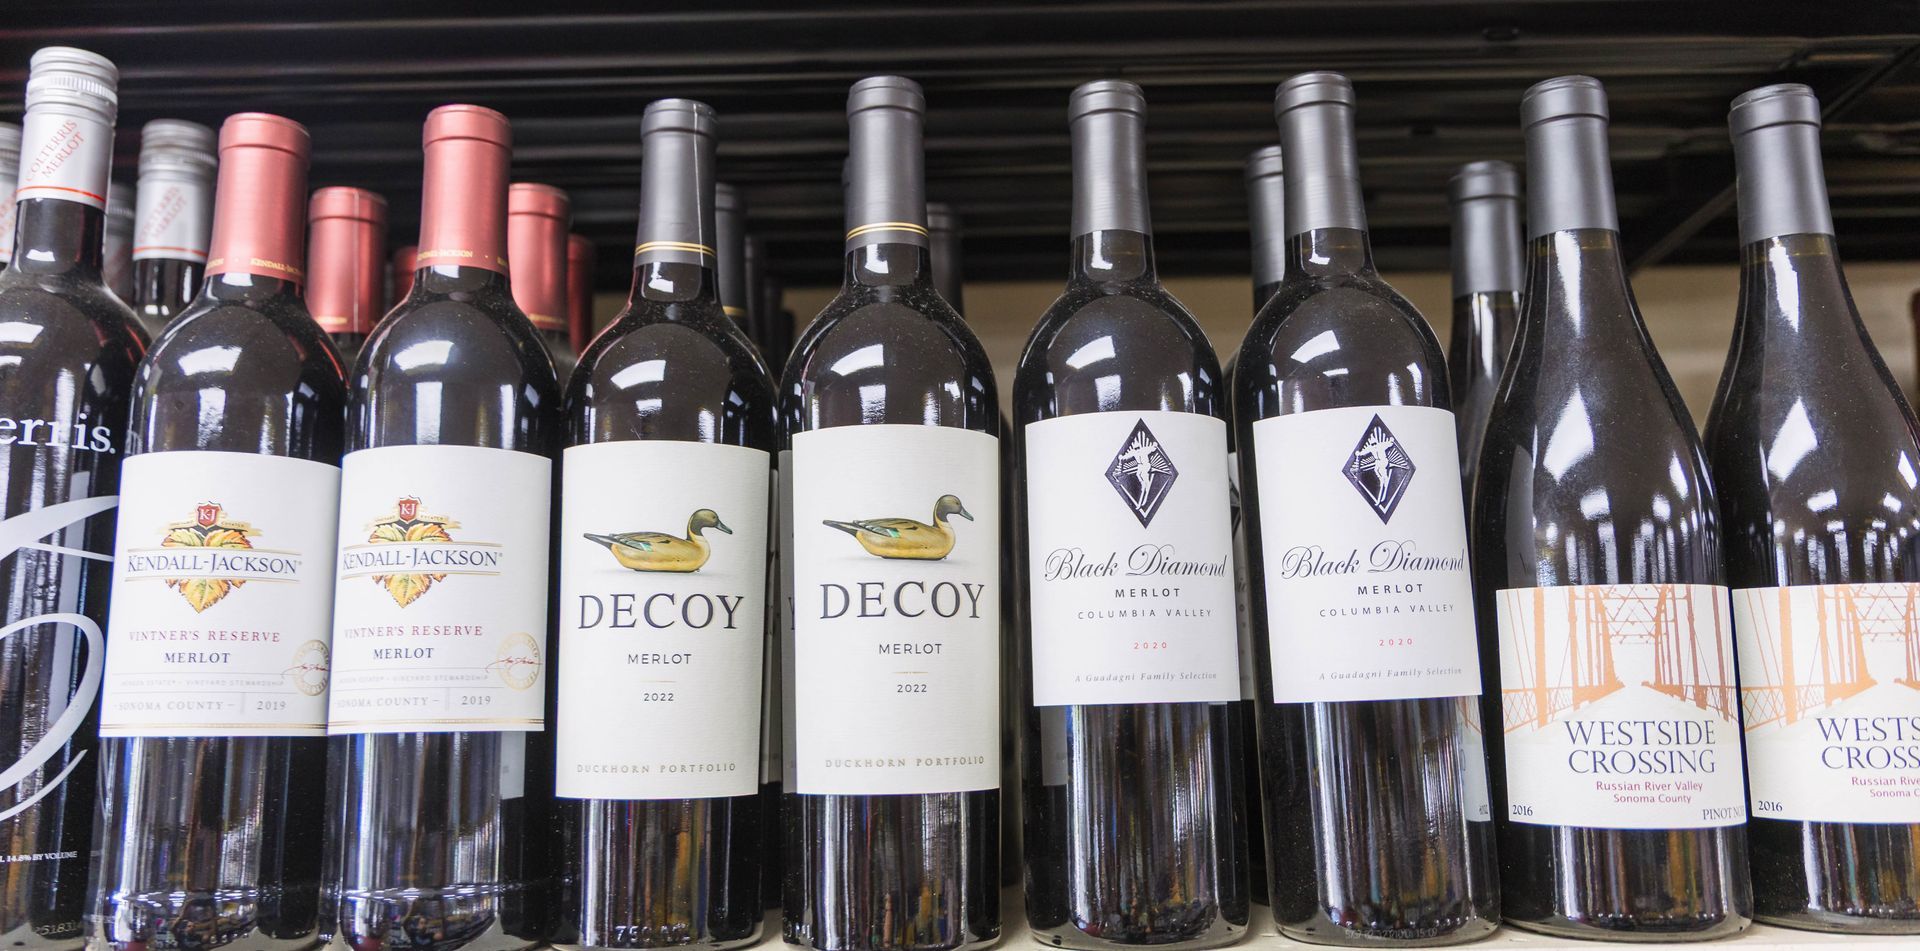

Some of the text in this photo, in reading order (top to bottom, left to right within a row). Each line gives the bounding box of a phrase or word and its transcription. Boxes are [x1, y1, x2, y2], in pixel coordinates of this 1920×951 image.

[41, 131, 84, 178] MERLOT
[1045, 543, 1227, 581] Black Diamond
[1281, 540, 1465, 580] Black Diamond
[1115, 588, 1181, 598] MERLOT
[1357, 583, 1423, 595] MERLOT
[820, 580, 985, 620] DECOY
[578, 592, 745, 630] DECOY
[1078, 609, 1212, 619] COLUMBIA VALLEY
[1319, 604, 1454, 617] COLUMBIA VALLEY
[129, 630, 281, 642] VINTNER'S RESERVE
[344, 625, 483, 639] VINTNER'S RESERVE
[1134, 641, 1168, 650] 2020
[1379, 638, 1413, 646] 2020
[373, 647, 434, 659] MERLOT
[878, 643, 942, 655] MERLOT
[164, 652, 231, 664] MERLOT
[627, 653, 692, 665] MERLOT
[1075, 672, 1217, 683] A Guadagni Family Selection
[1331, 669, 1382, 680] Guadagni
[1387, 668, 1423, 678] Family
[1426, 667, 1462, 675] Selection
[897, 684, 928, 693] 2022
[377, 697, 429, 706] COUNTY
[461, 695, 492, 705] 2019
[643, 692, 675, 702] 2022
[167, 700, 223, 711] COUNTY
[257, 700, 287, 711] 2019
[1564, 719, 1716, 745] WESTSIDE
[825, 755, 985, 768] DUCKHORN PORTFOLIO
[1568, 749, 1716, 774] CROSSING
[577, 763, 736, 774] DUCKHORN PORTFOLIO
[1596, 780, 1703, 792] Russian River Valley
[1851, 776, 1897, 786] Russian
[1613, 794, 1691, 804] Sonoma County
[1870, 789, 1911, 798] Sonoma
[1512, 804, 1533, 817] 2016
[1758, 801, 1783, 812] 2016
[1703, 808, 1732, 820] PINOT
[32, 853, 43, 861] BY
[45, 850, 78, 860] VOLUME
